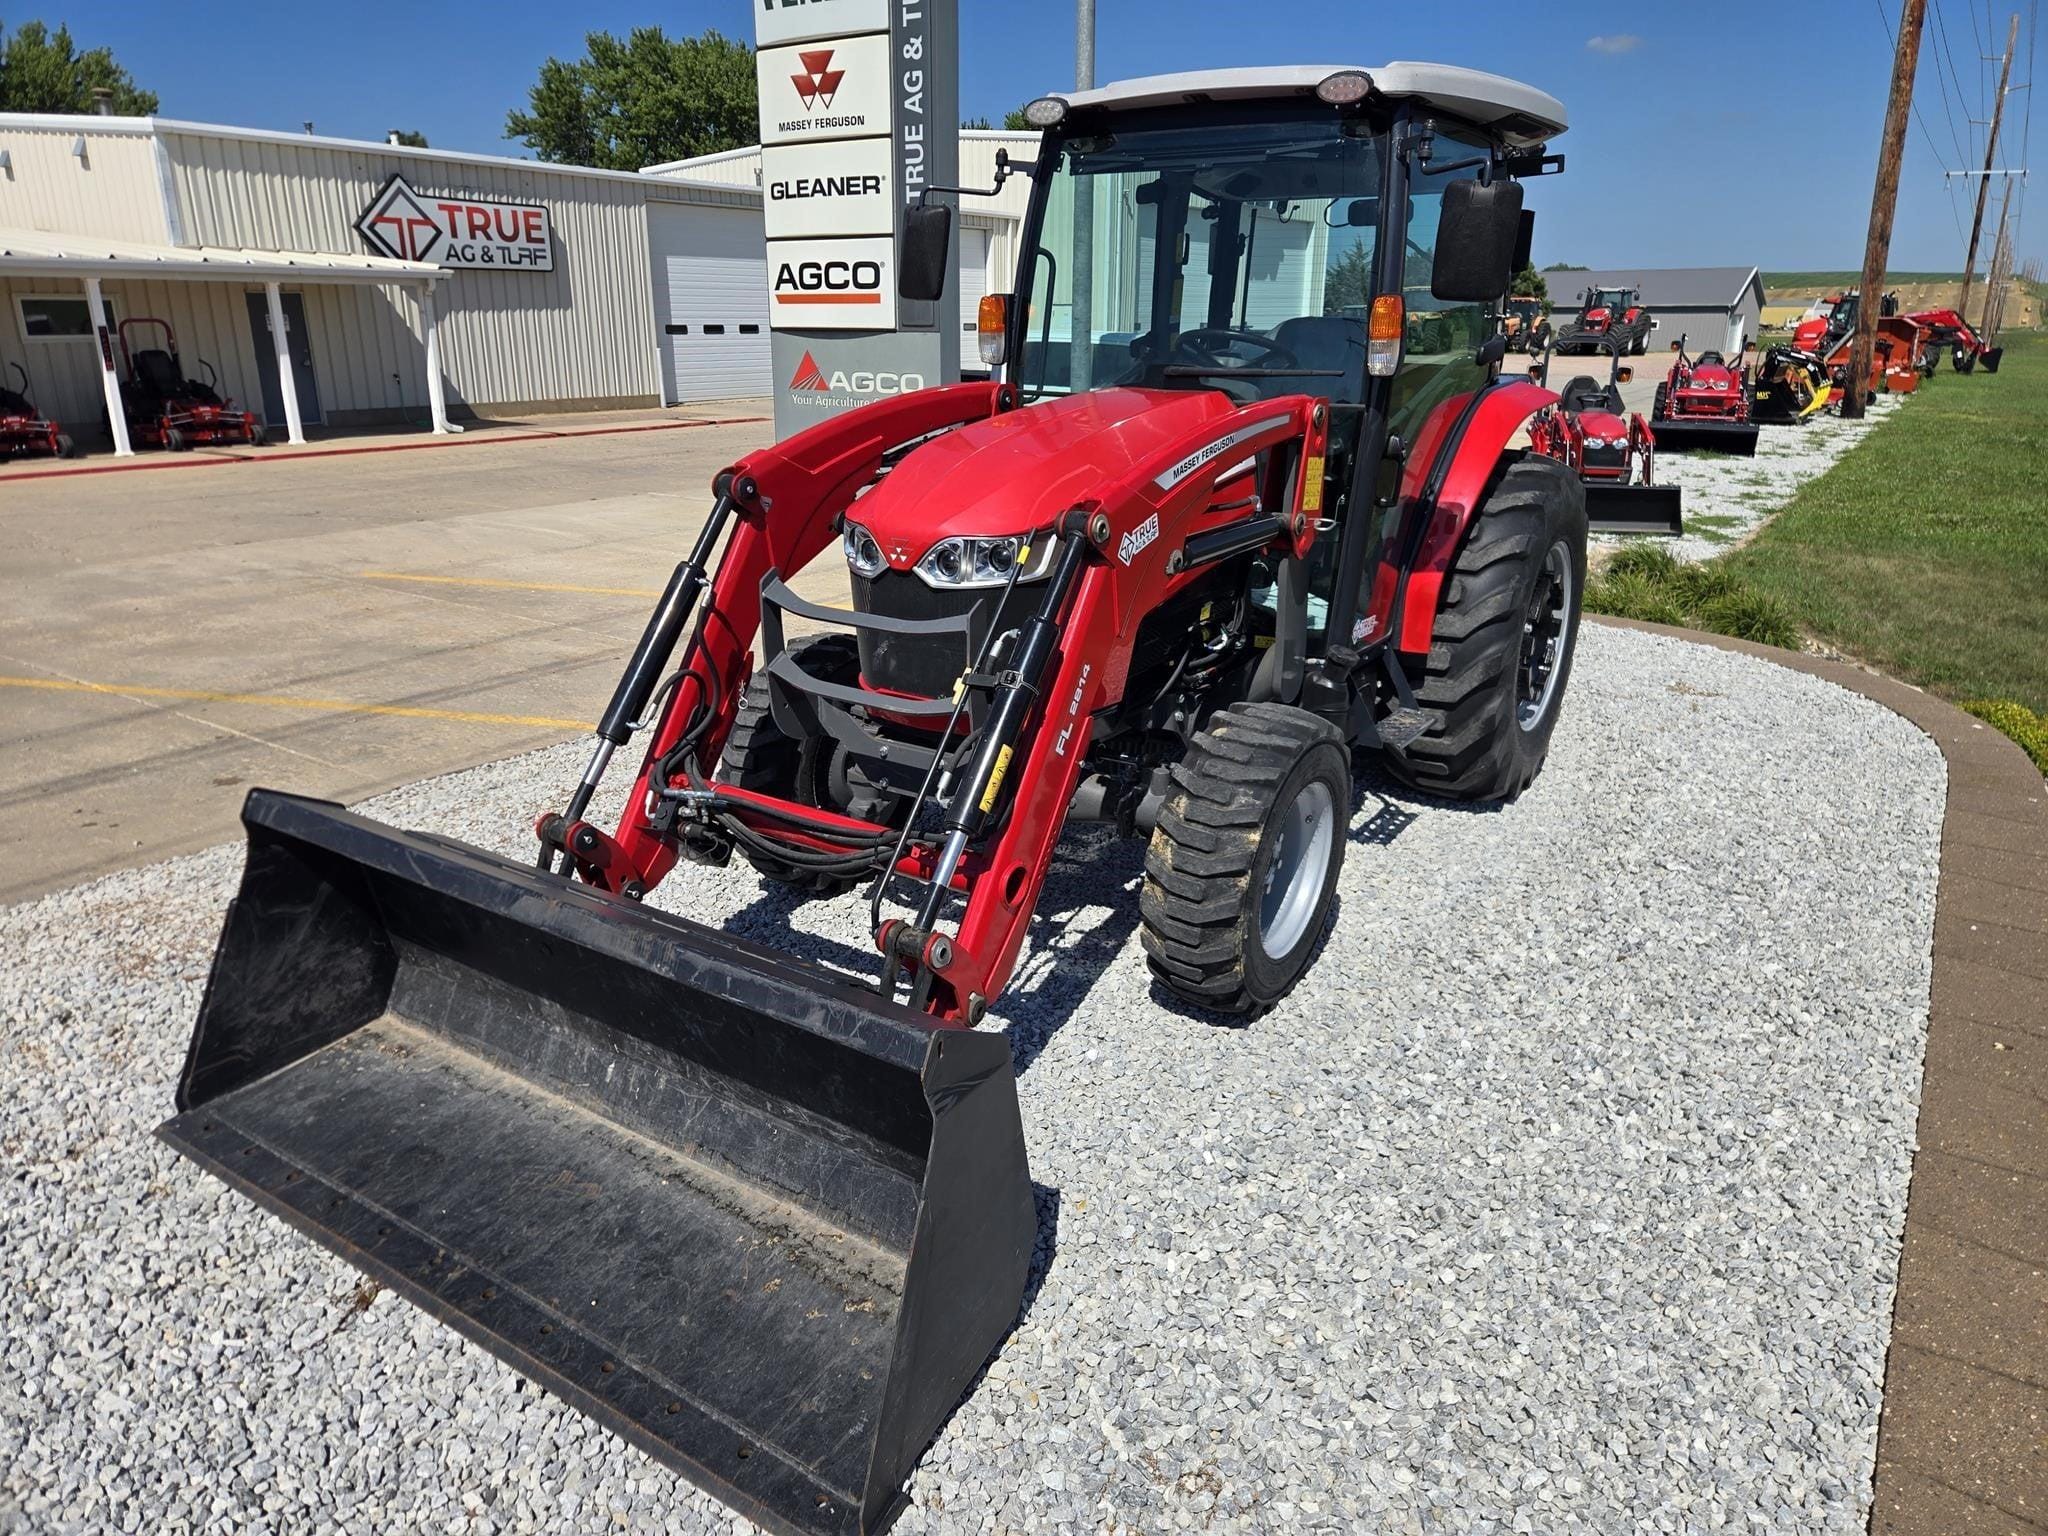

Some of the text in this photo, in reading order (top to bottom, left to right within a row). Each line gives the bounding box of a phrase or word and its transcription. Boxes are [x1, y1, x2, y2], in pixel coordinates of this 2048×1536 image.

[903, 35, 923, 60] &
[903, 70, 923, 115] AG
[778, 115, 865, 133] MASSEY FERGUSON
[905, 123, 923, 204] TRUE
[770, 175, 881, 201] GLEANER
[437, 203, 546, 245] TRUE
[445, 243, 547, 266] AG & TURF
[774, 261, 881, 291] AGCO
[829, 371, 924, 394] AGCO
[791, 394, 812, 405] Your
[1172, 434, 1235, 480] MASSEY FERGUSON
[1134, 516, 1158, 542] TRUE
[1055, 664, 1091, 756] FL 2814
